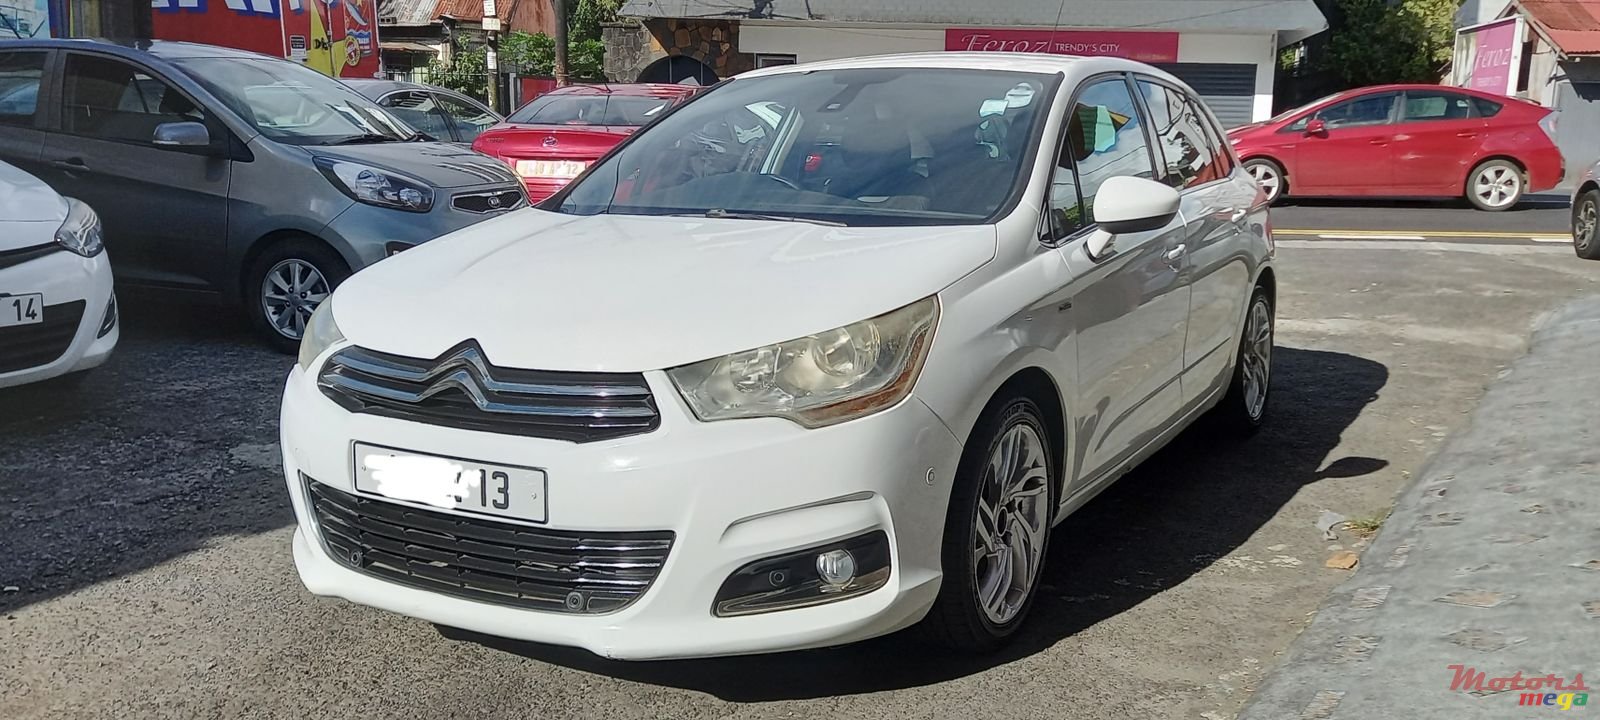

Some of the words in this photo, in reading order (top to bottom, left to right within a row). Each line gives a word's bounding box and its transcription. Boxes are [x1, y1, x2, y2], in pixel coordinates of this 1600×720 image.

[1055, 43, 1097, 52] TRENDY'S
[1100, 44, 1119, 53] CITY
[12, 298, 37, 321] 14
[480, 469, 509, 510] 13
